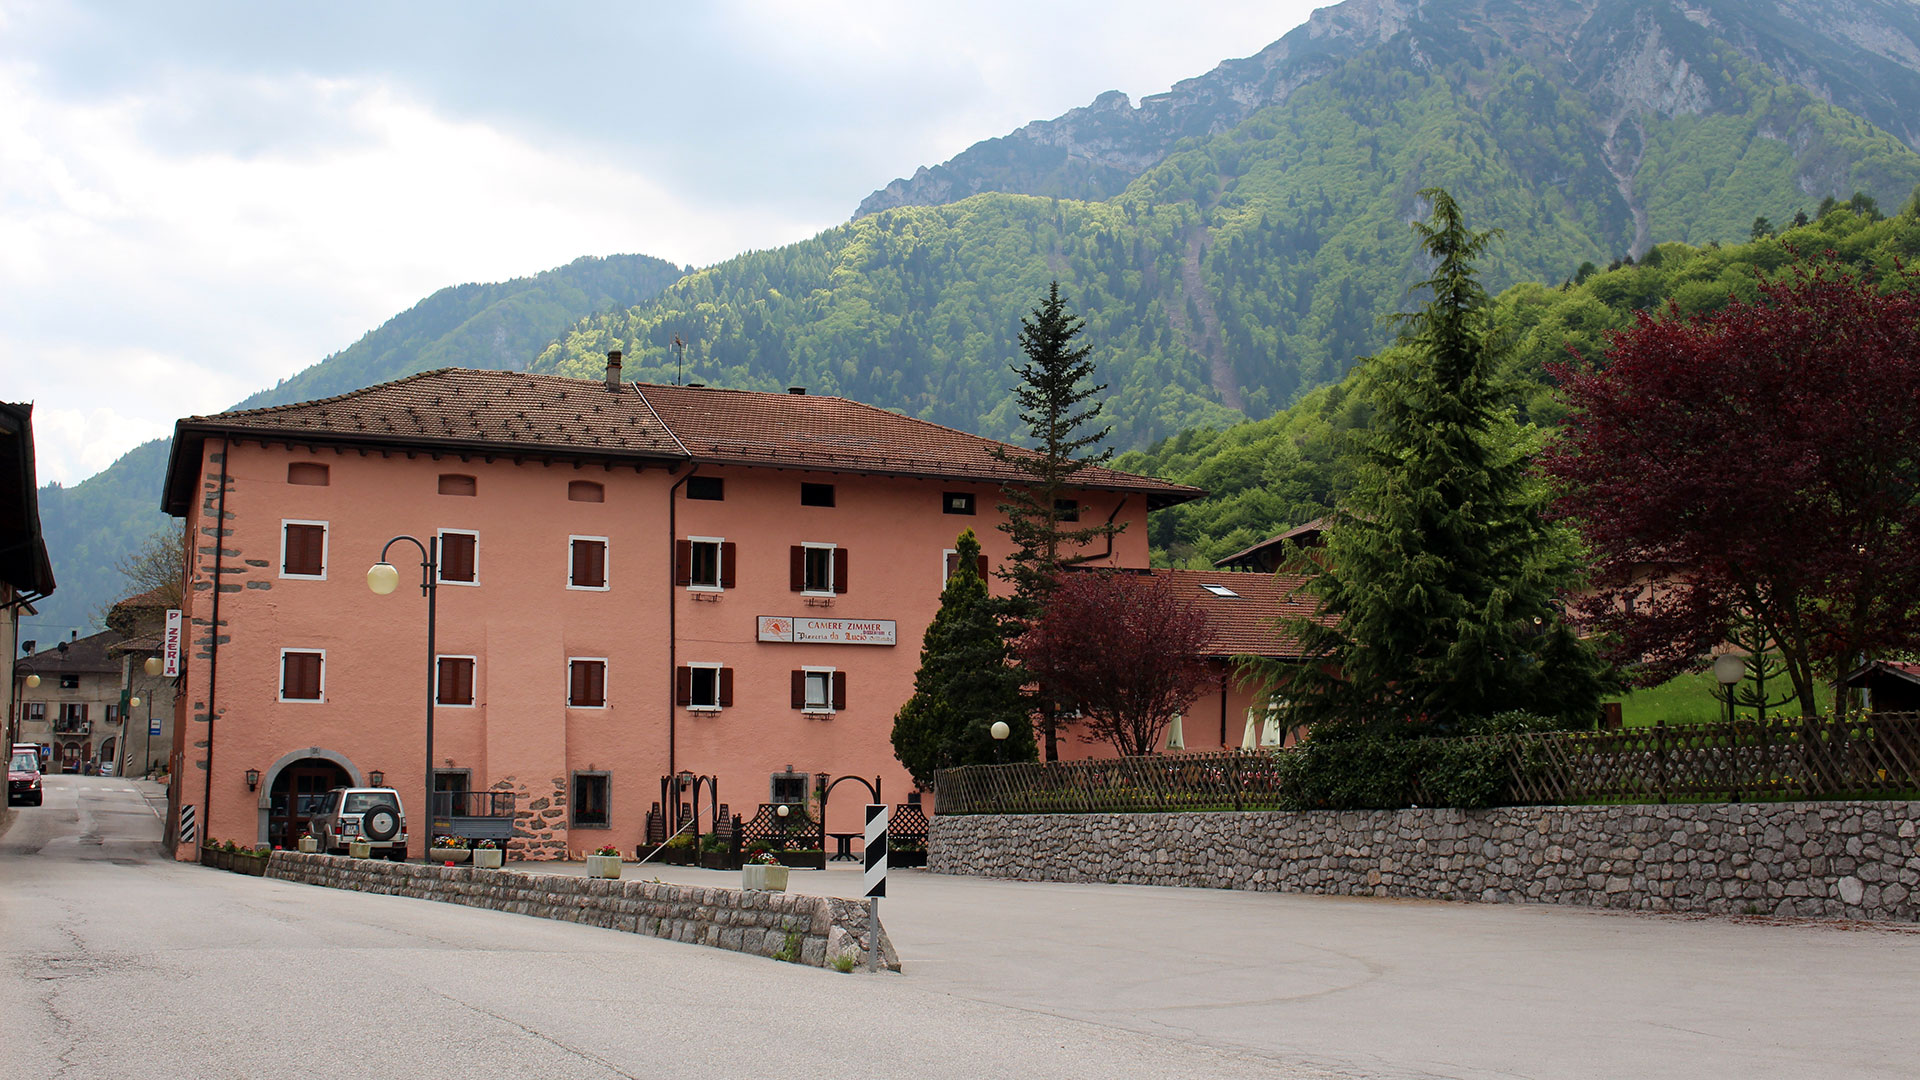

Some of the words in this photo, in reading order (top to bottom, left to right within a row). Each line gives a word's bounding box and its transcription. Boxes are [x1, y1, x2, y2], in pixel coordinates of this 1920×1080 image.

[808, 621, 842, 630] CAMERE
[848, 622, 881, 631] ZIMMER
[797, 632, 828, 640] Pizzeria
[830, 631, 839, 640] da
[845, 631, 867, 641] Lucio
[167, 612, 179, 674] PZZERIA
